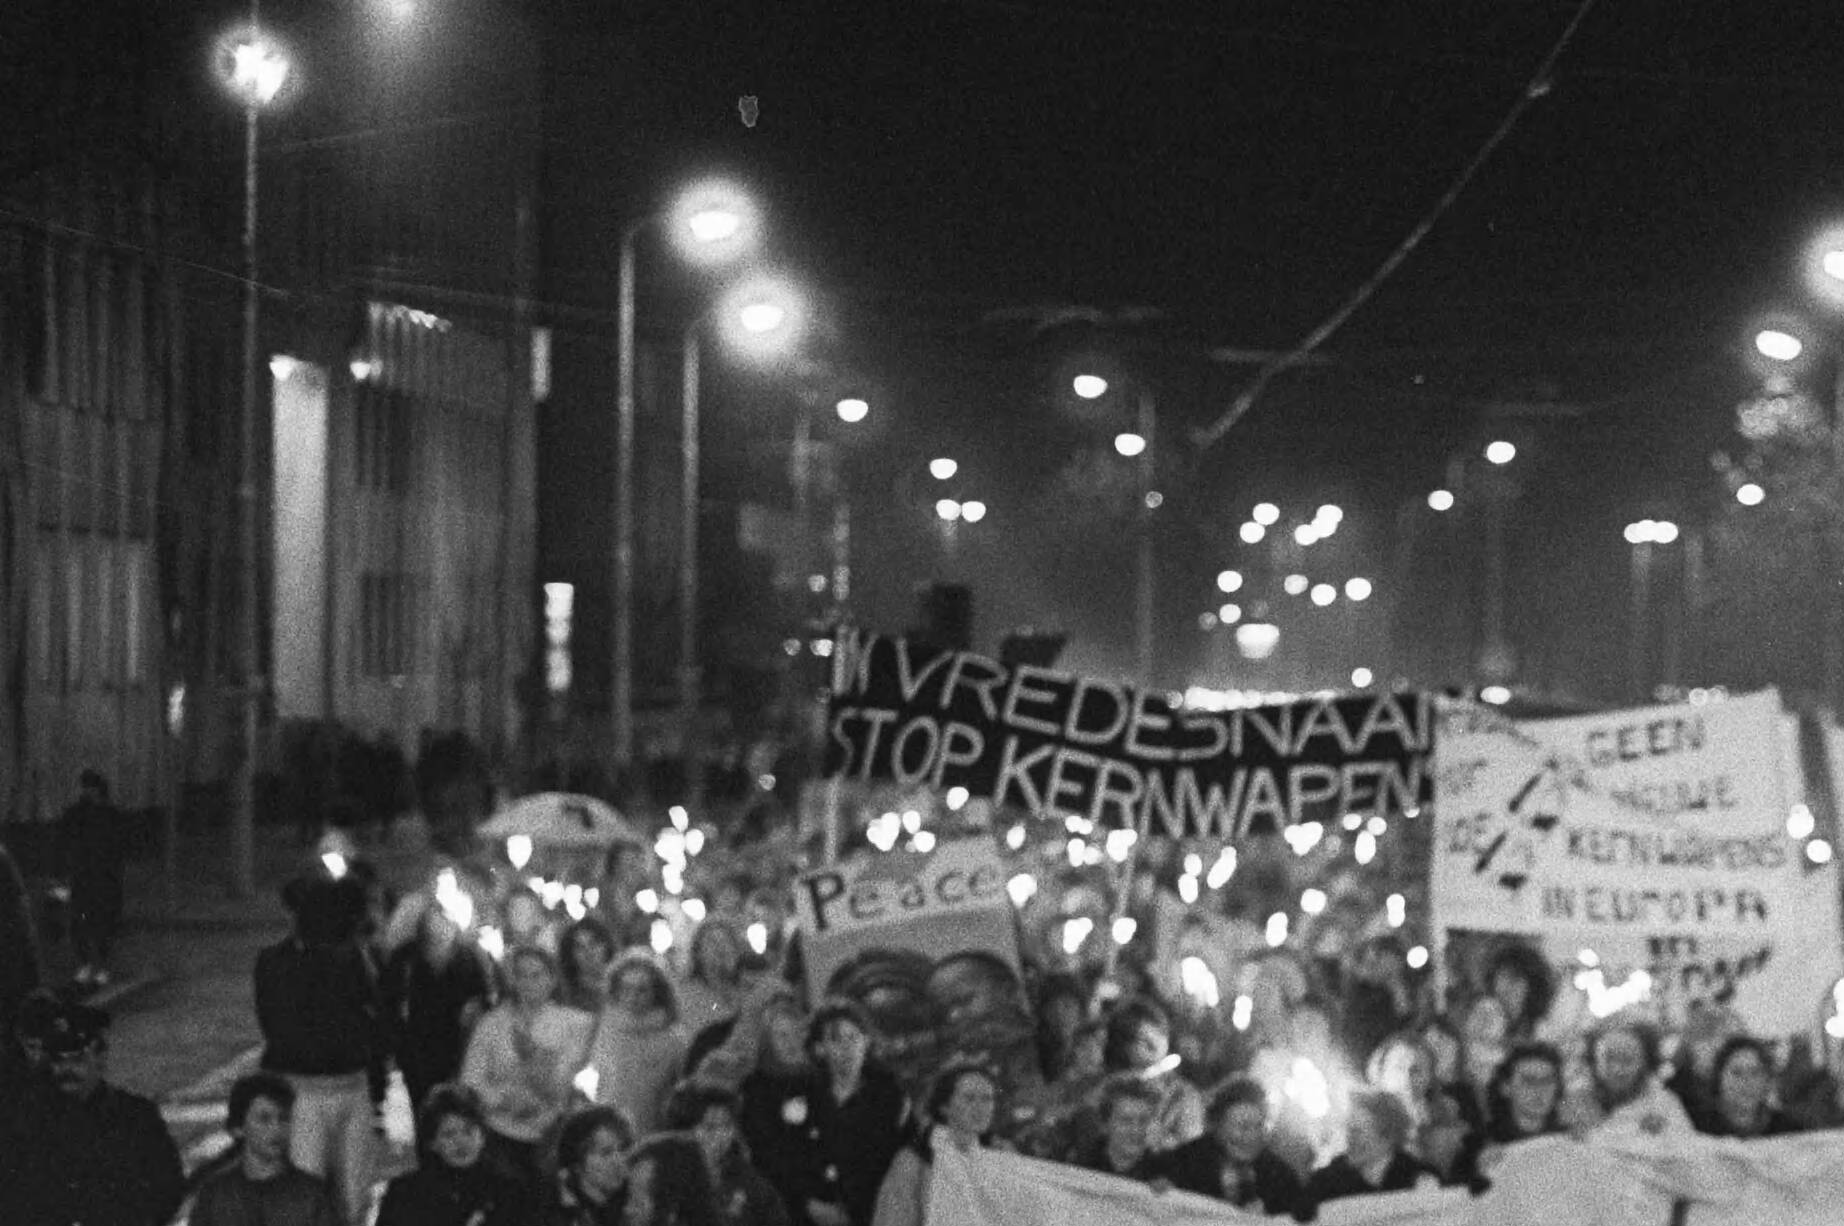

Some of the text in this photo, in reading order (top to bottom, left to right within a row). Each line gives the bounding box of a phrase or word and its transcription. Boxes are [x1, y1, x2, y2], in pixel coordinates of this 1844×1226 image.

[832, 706, 985, 788] STOP
[993, 735, 1436, 840] KERNWAPEN
[1587, 718, 1705, 768] GEEN
[803, 864, 1003, 932] Peace
